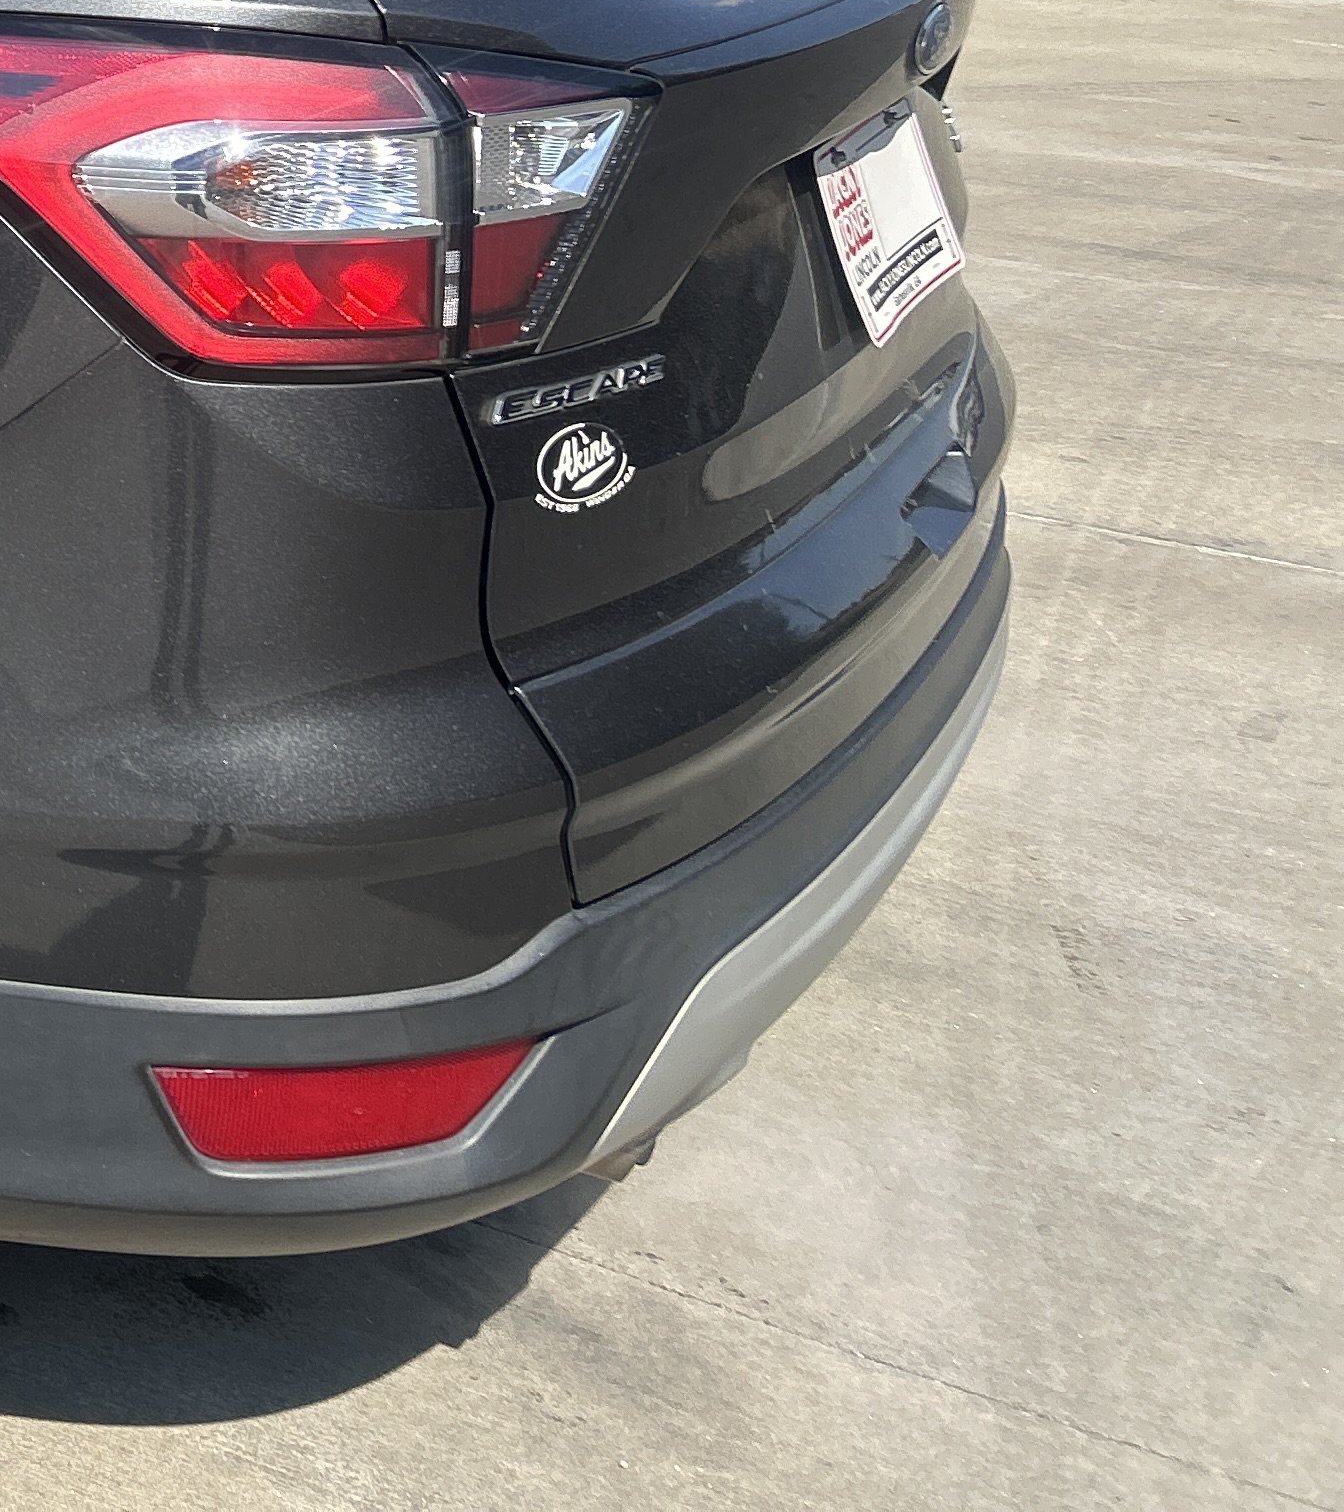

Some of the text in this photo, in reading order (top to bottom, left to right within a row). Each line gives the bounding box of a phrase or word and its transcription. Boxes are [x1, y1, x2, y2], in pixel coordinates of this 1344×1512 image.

[839, 199, 873, 261] JONES
[852, 245, 881, 287] LINCOLN
[490, 353, 665, 426] ESCAPE
[553, 430, 616, 492] Akins
[534, 493, 555, 510] EST
